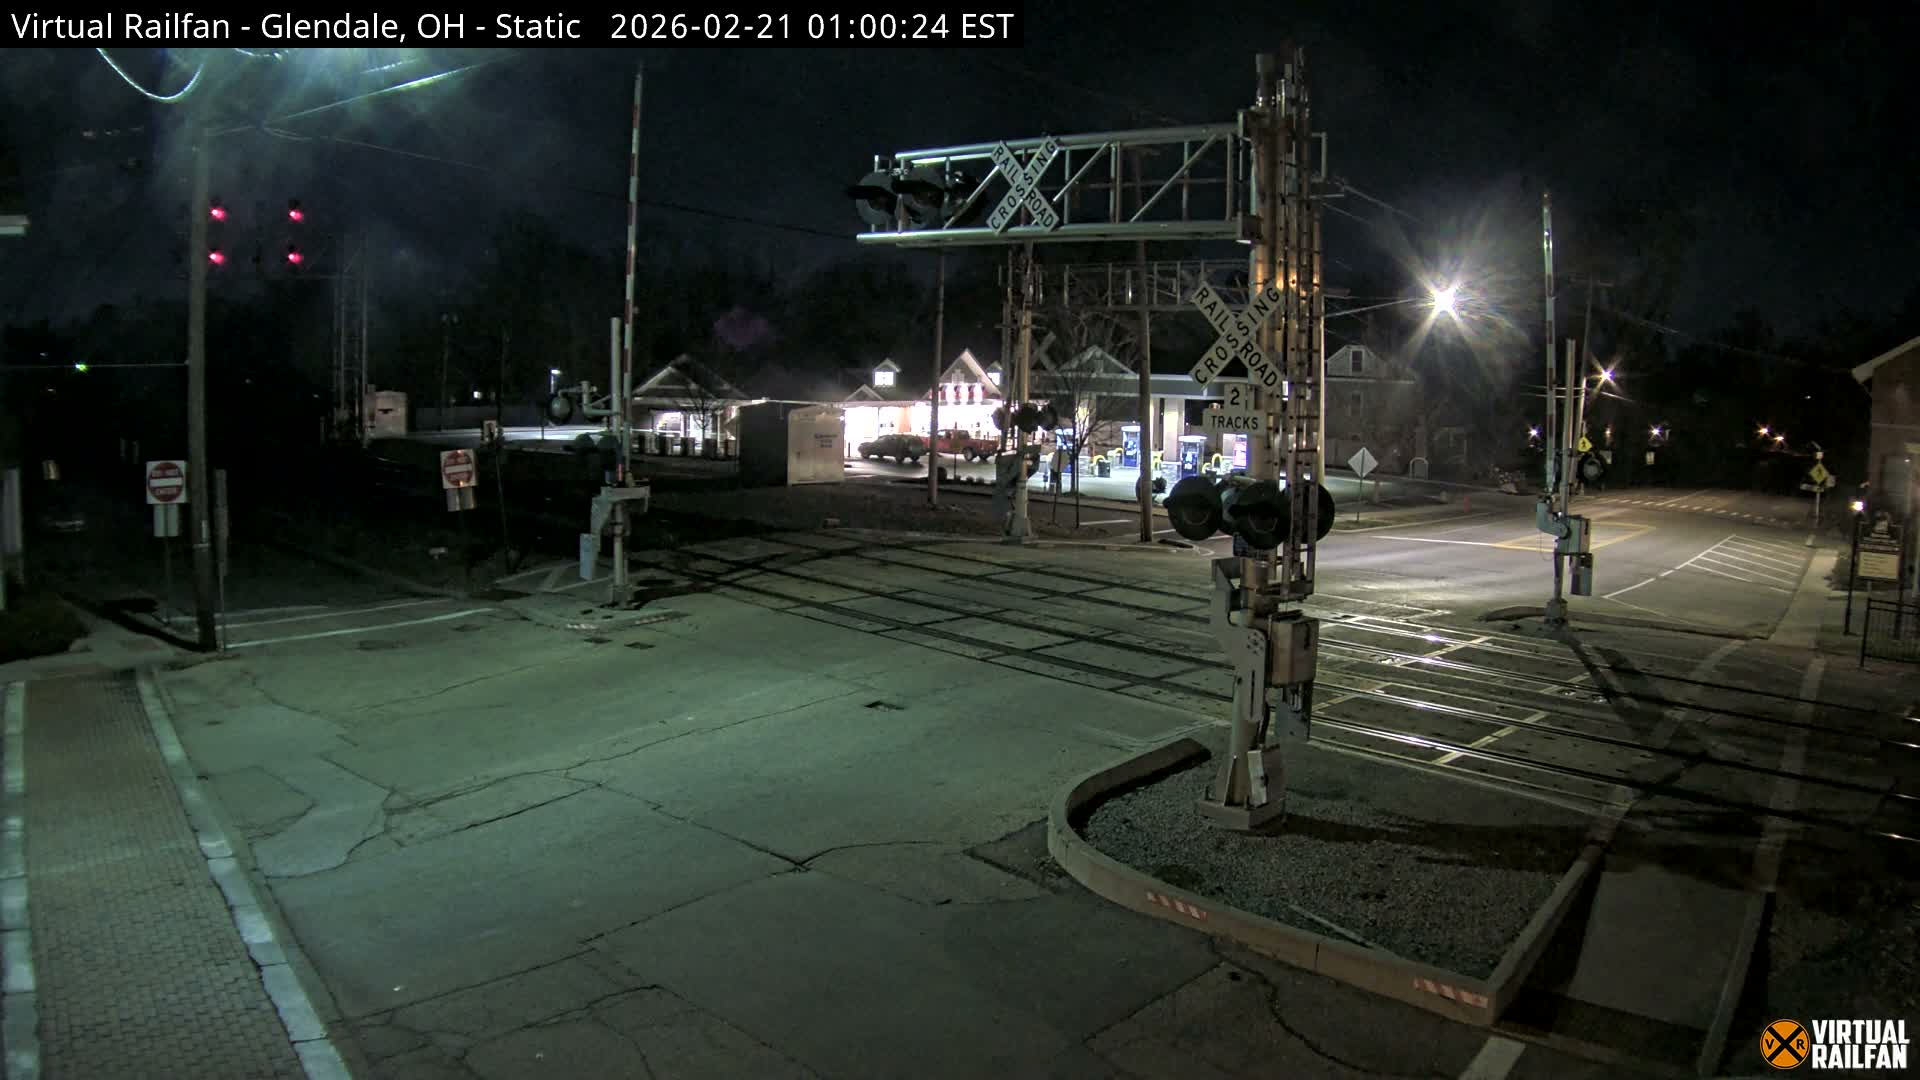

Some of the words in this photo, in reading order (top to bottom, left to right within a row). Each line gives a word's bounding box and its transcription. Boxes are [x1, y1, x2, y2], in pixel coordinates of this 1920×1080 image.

[990, 140, 1057, 230] CROSSING
[993, 145, 1055, 228] RAILROAD
[1193, 286, 1281, 386] CROSSING
[1195, 287, 1278, 388] RAILROAD
[1210, 415, 1259, 431] TRACKS
[1229, 386, 1241, 406] 2
